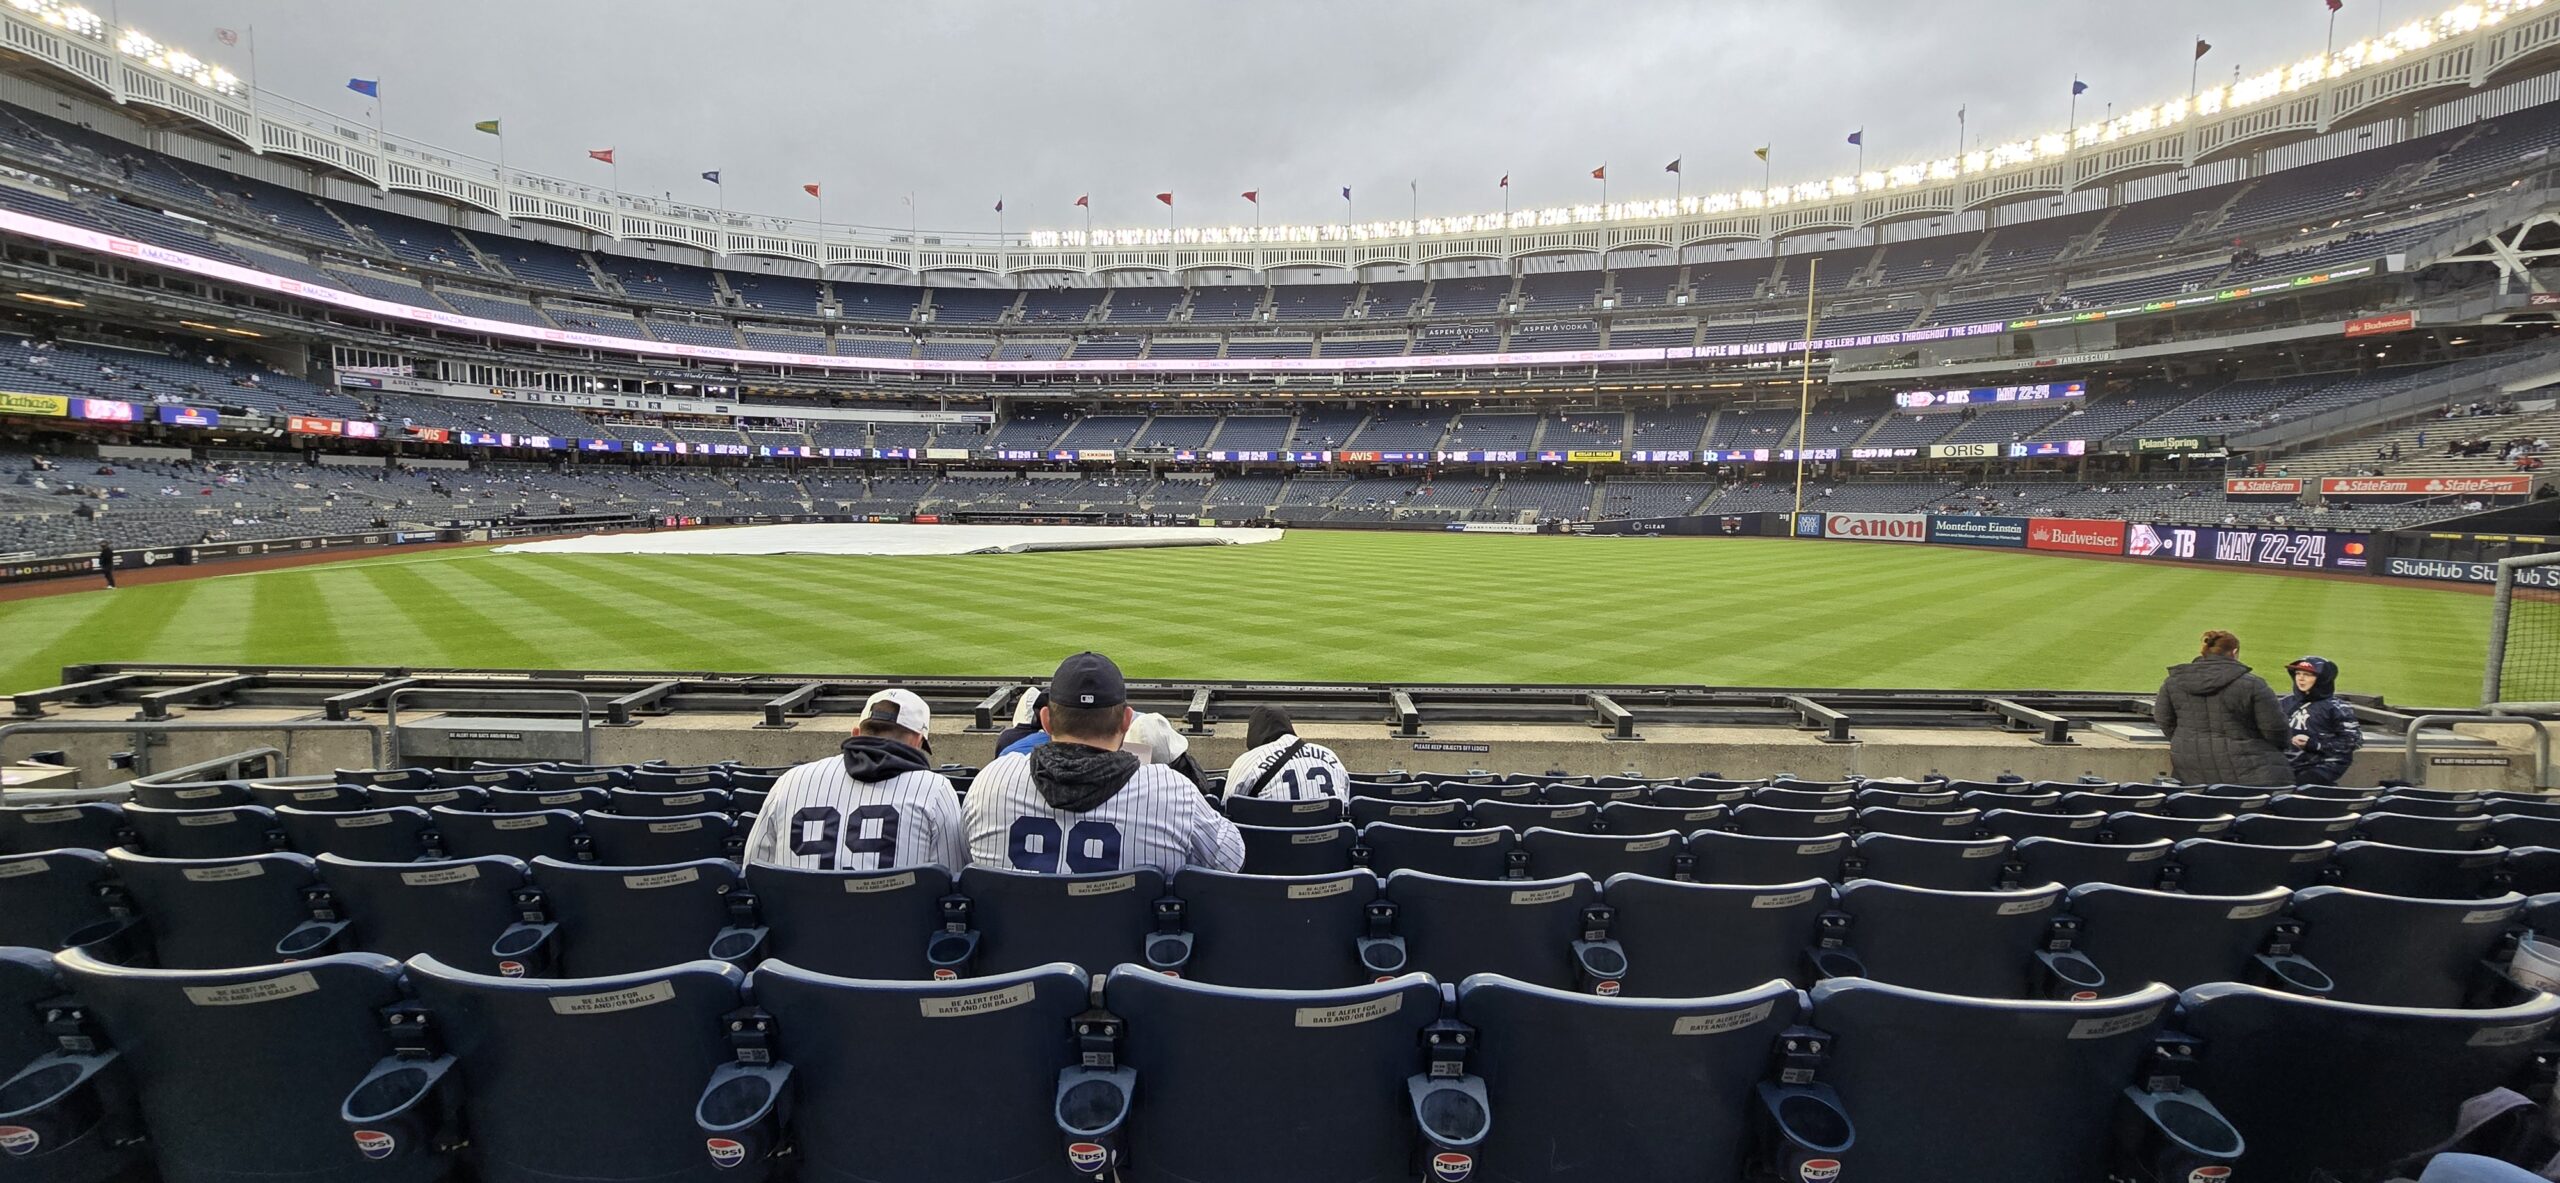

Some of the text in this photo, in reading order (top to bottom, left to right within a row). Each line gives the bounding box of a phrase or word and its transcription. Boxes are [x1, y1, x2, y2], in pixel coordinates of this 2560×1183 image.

[2364, 319, 2410, 330] Budweiser
[1430, 328, 1454, 336] ASPEN
[1695, 345, 1727, 357] RAFFLE
[1728, 344, 1740, 355] ON
[1742, 342, 1764, 355] SALE
[1766, 342, 1788, 353] NOW
[1789, 340, 1807, 351] LOOK
[1810, 340, 1823, 349] FOR
[1824, 338, 1855, 349] SELLERS
[1856, 336, 1872, 346] AND
[1873, 333, 1900, 344] KIOSKS
[1902, 328, 1950, 341] THROUGHOUT
[1951, 326, 1966, 336] THE
[1968, 323, 2003, 334] STADIUM
[2060, 355, 2089, 365] YANKEES
[2091, 353, 2109, 361] CLUB
[1946, 385, 2050, 403] RAYS MAY 22-24
[417, 429, 440, 440] AVIS
[2139, 437, 2198, 450] Poland Spring
[1815, 449, 1837, 459] 22-24
[1877, 449, 1892, 458] PM
[1943, 444, 1984, 456] ORIS
[1350, 452, 1372, 460] AVIS
[1653, 451, 1666, 461] MAY
[1667, 451, 1689, 461] 22-24
[1828, 515, 1923, 538] Canon
[1936, 520, 2022, 533] Montefiore Einstein
[2051, 529, 2118, 547] Budweiser
[2174, 530, 2326, 566] TB MAY 22-24
[2392, 560, 2462, 579] StubHub
[1282, 766, 1336, 800] 13
[790, 804, 900, 870] 99
[594, 1000, 628, 1009] AND/OR
[629, 994, 655, 1004] BALLS
[595, 995, 620, 1004] ALERT
[960, 1002, 993, 1011] AND/OR
[994, 996, 1018, 1006] BALLS
[964, 996, 988, 1005] ALERT
[1334, 1012, 1364, 1022] AND/OR
[1366, 1006, 1387, 1017] BALLS
[1338, 1007, 1361, 1016] ALERT
[1716, 1015, 1738, 1023] ALERT
[1740, 1015, 1759, 1024] BALLS
[710, 1147, 742, 1156] PEPSI
[1071, 1151, 1104, 1160] PEPSI
[1436, 1161, 1470, 1170] PEPSI
[1804, 1167, 1838, 1176] PEPSI
